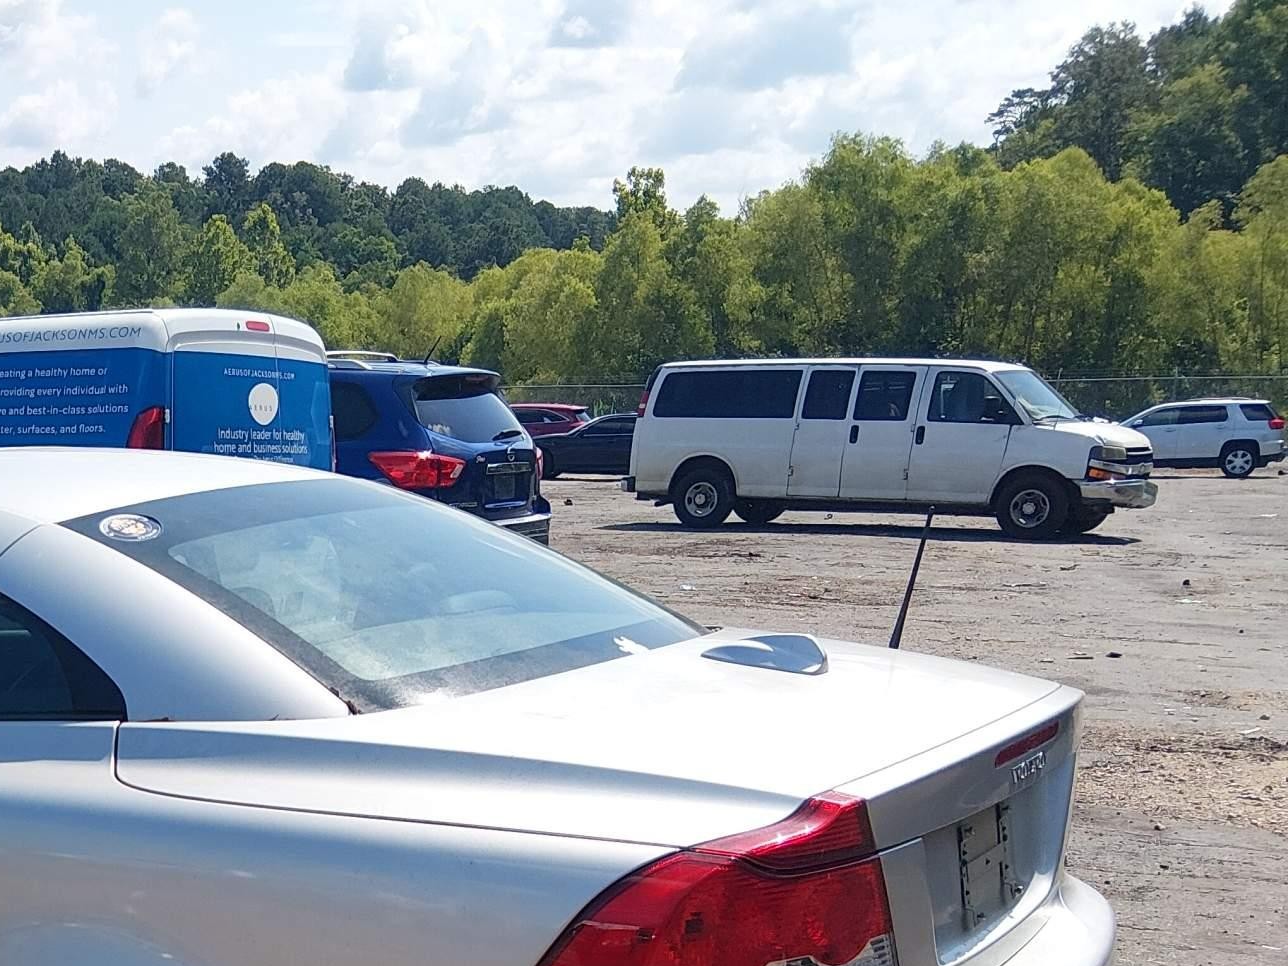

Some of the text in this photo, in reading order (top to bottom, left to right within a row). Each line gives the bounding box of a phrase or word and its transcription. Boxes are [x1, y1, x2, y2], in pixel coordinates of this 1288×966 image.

[34, 367, 68, 379] healthy
[70, 367, 96, 376] home
[97, 367, 108, 376] or
[36, 386, 62, 398] every
[63, 385, 107, 396] individual
[108, 384, 129, 394] with
[8, 406, 25, 416] and
[26, 404, 86, 416] best-in-class
[87, 403, 129, 414] solutions
[17, 423, 58, 436] surfaces,
[59, 423, 77, 434] and
[78, 423, 106, 434] floors.
[217, 427, 305, 443] Industry leader for healthy
[214, 441, 308, 454] home and business solutions
